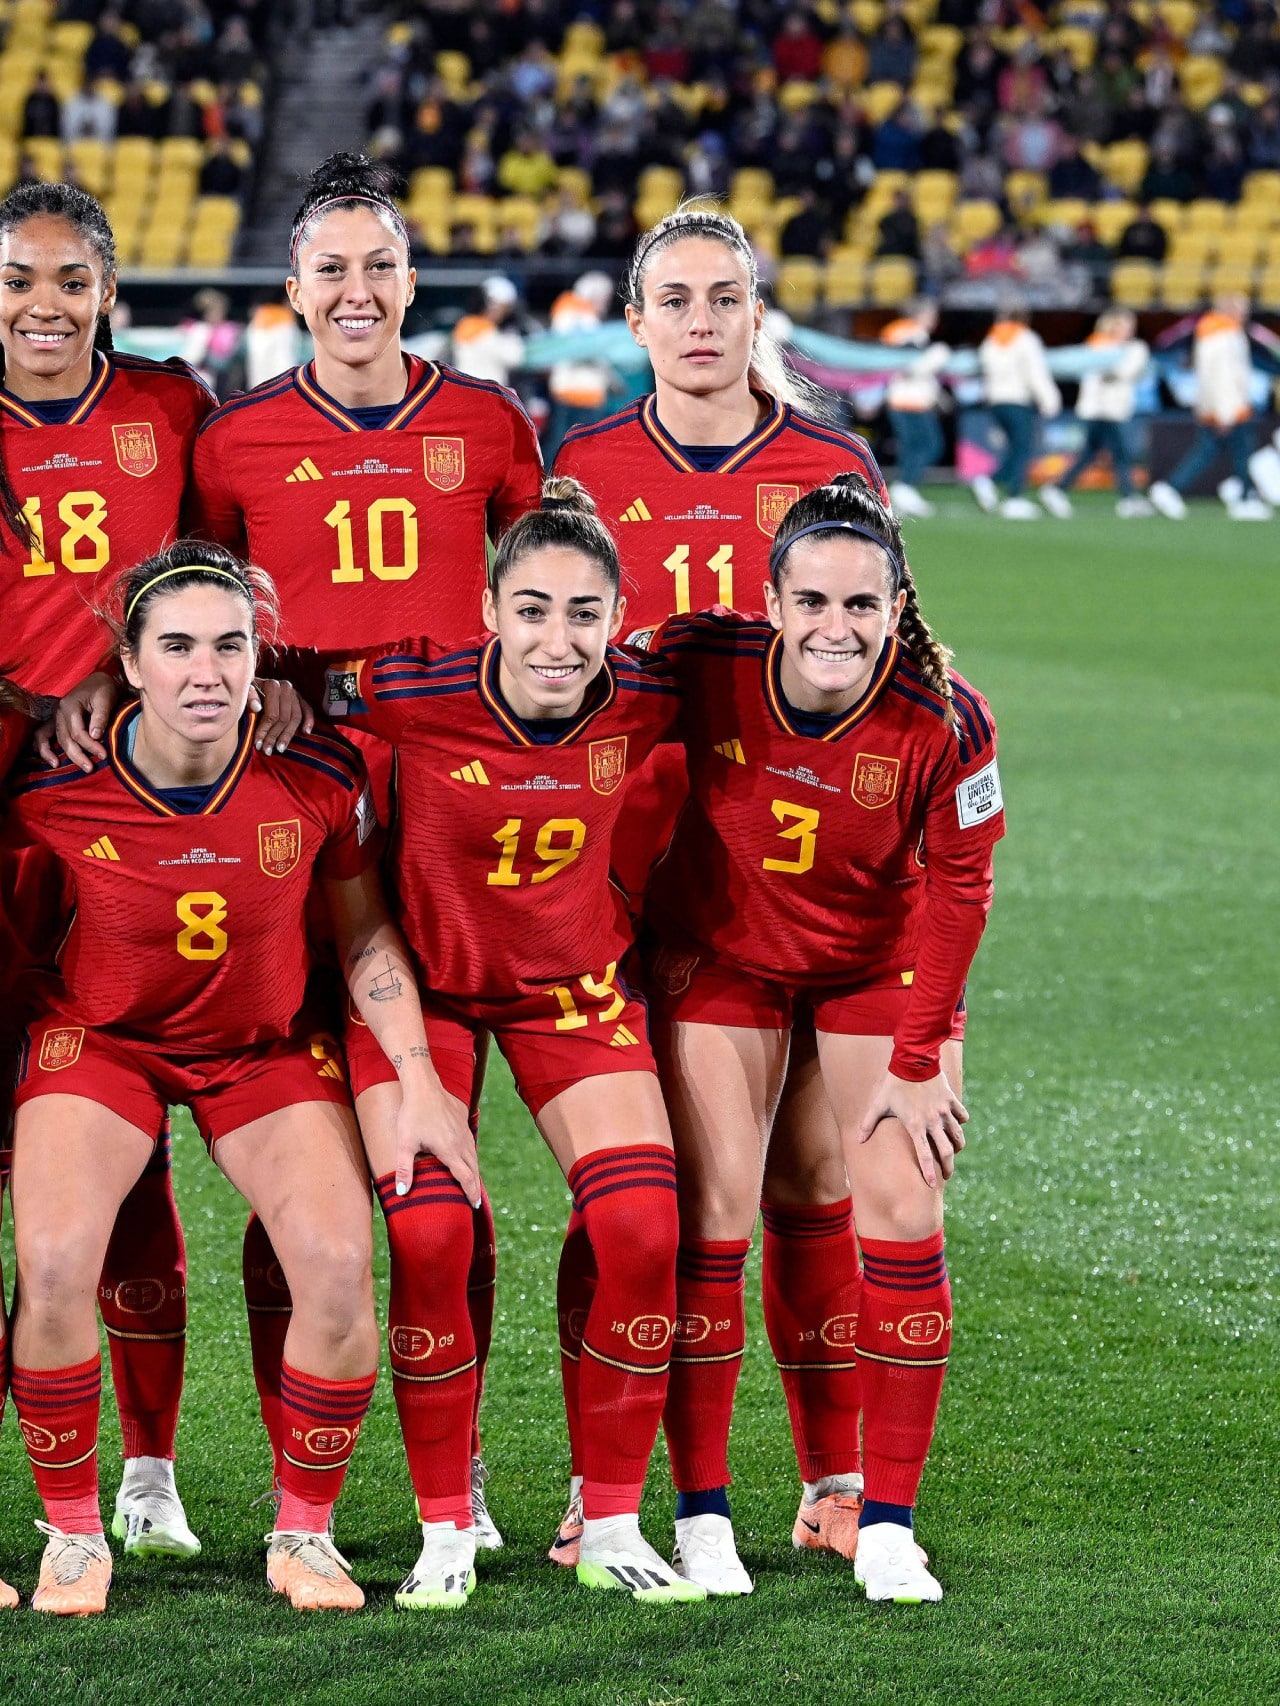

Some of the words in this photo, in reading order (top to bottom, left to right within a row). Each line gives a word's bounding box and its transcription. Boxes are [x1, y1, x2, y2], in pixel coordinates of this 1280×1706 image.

[15, 491, 110, 577] 18
[323, 498, 419, 583] 10
[662, 545, 734, 618] 11
[968, 773, 993, 792] FOOTBALL
[968, 780, 995, 800] UNITES
[763, 799, 820, 875] 3
[487, 818, 587, 886] 19
[176, 891, 228, 961] 8
[101, 1286, 113, 1300] 19
[611, 1321, 626, 1334] 19
[714, 1319, 731, 1331] 09
[879, 1321, 894, 1333] 19
[438, 1333, 455, 1348] 09
[798, 1331, 816, 1342] 19
[60, 1429, 77, 1443] 09
[291, 1427, 303, 1441] 19
